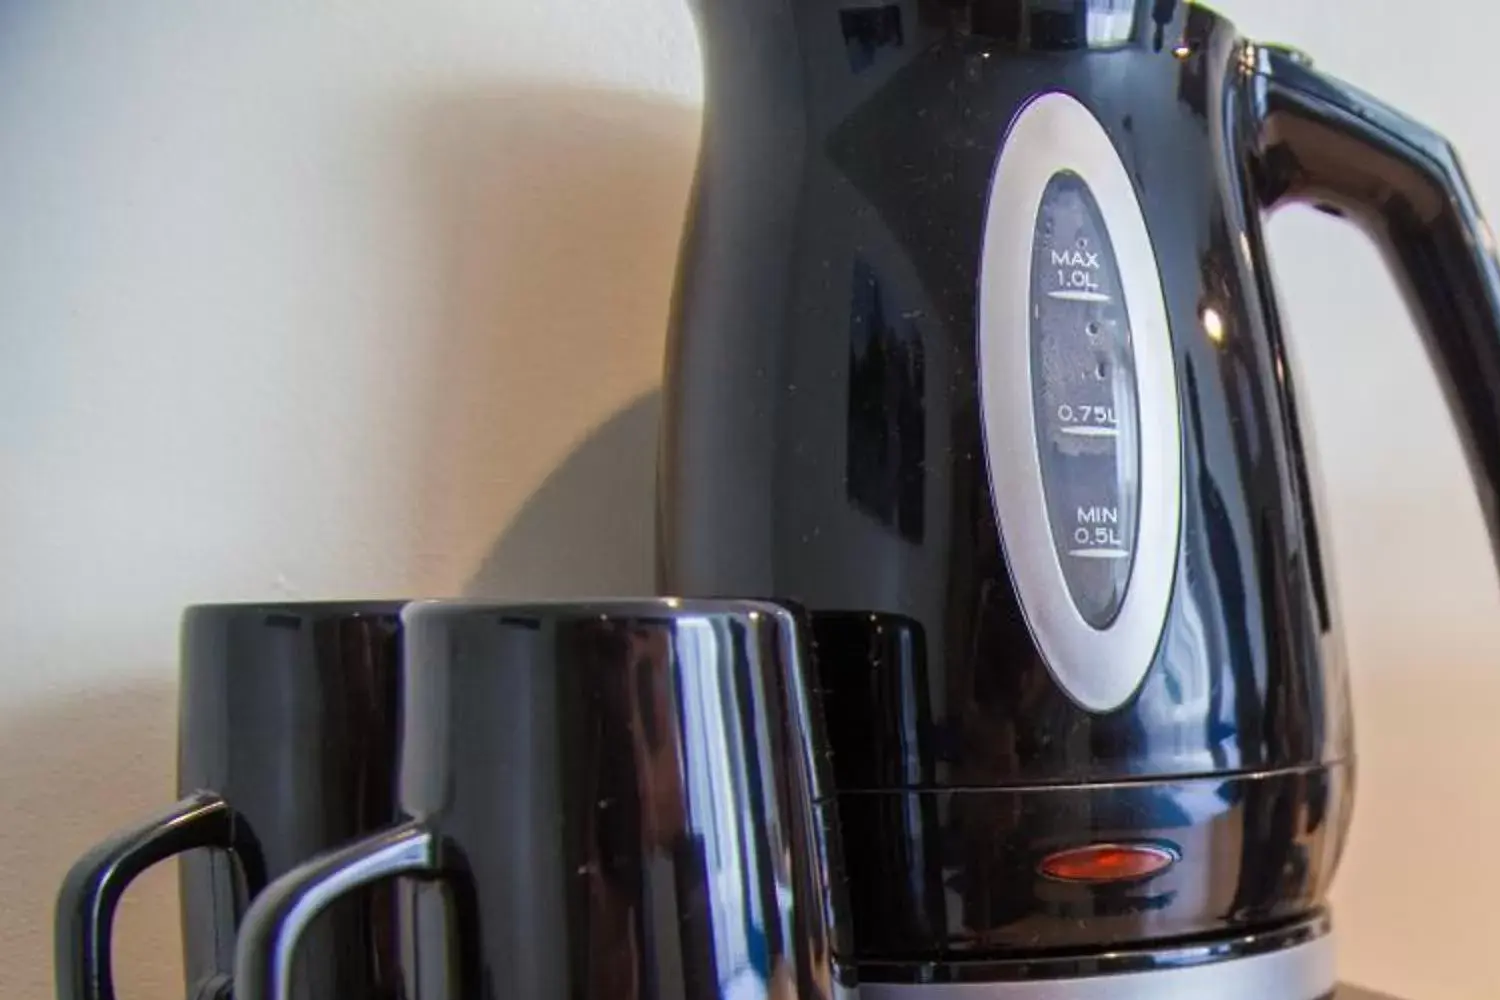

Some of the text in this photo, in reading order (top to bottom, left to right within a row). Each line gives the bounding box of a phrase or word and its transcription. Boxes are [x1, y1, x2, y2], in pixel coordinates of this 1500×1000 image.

[1051, 250, 1100, 267] MAX
[1057, 271, 1098, 289] 1.0L
[1057, 405, 1119, 423] 0.75L
[1077, 507, 1117, 523] MIN
[1074, 528, 1121, 545] 0.5L
